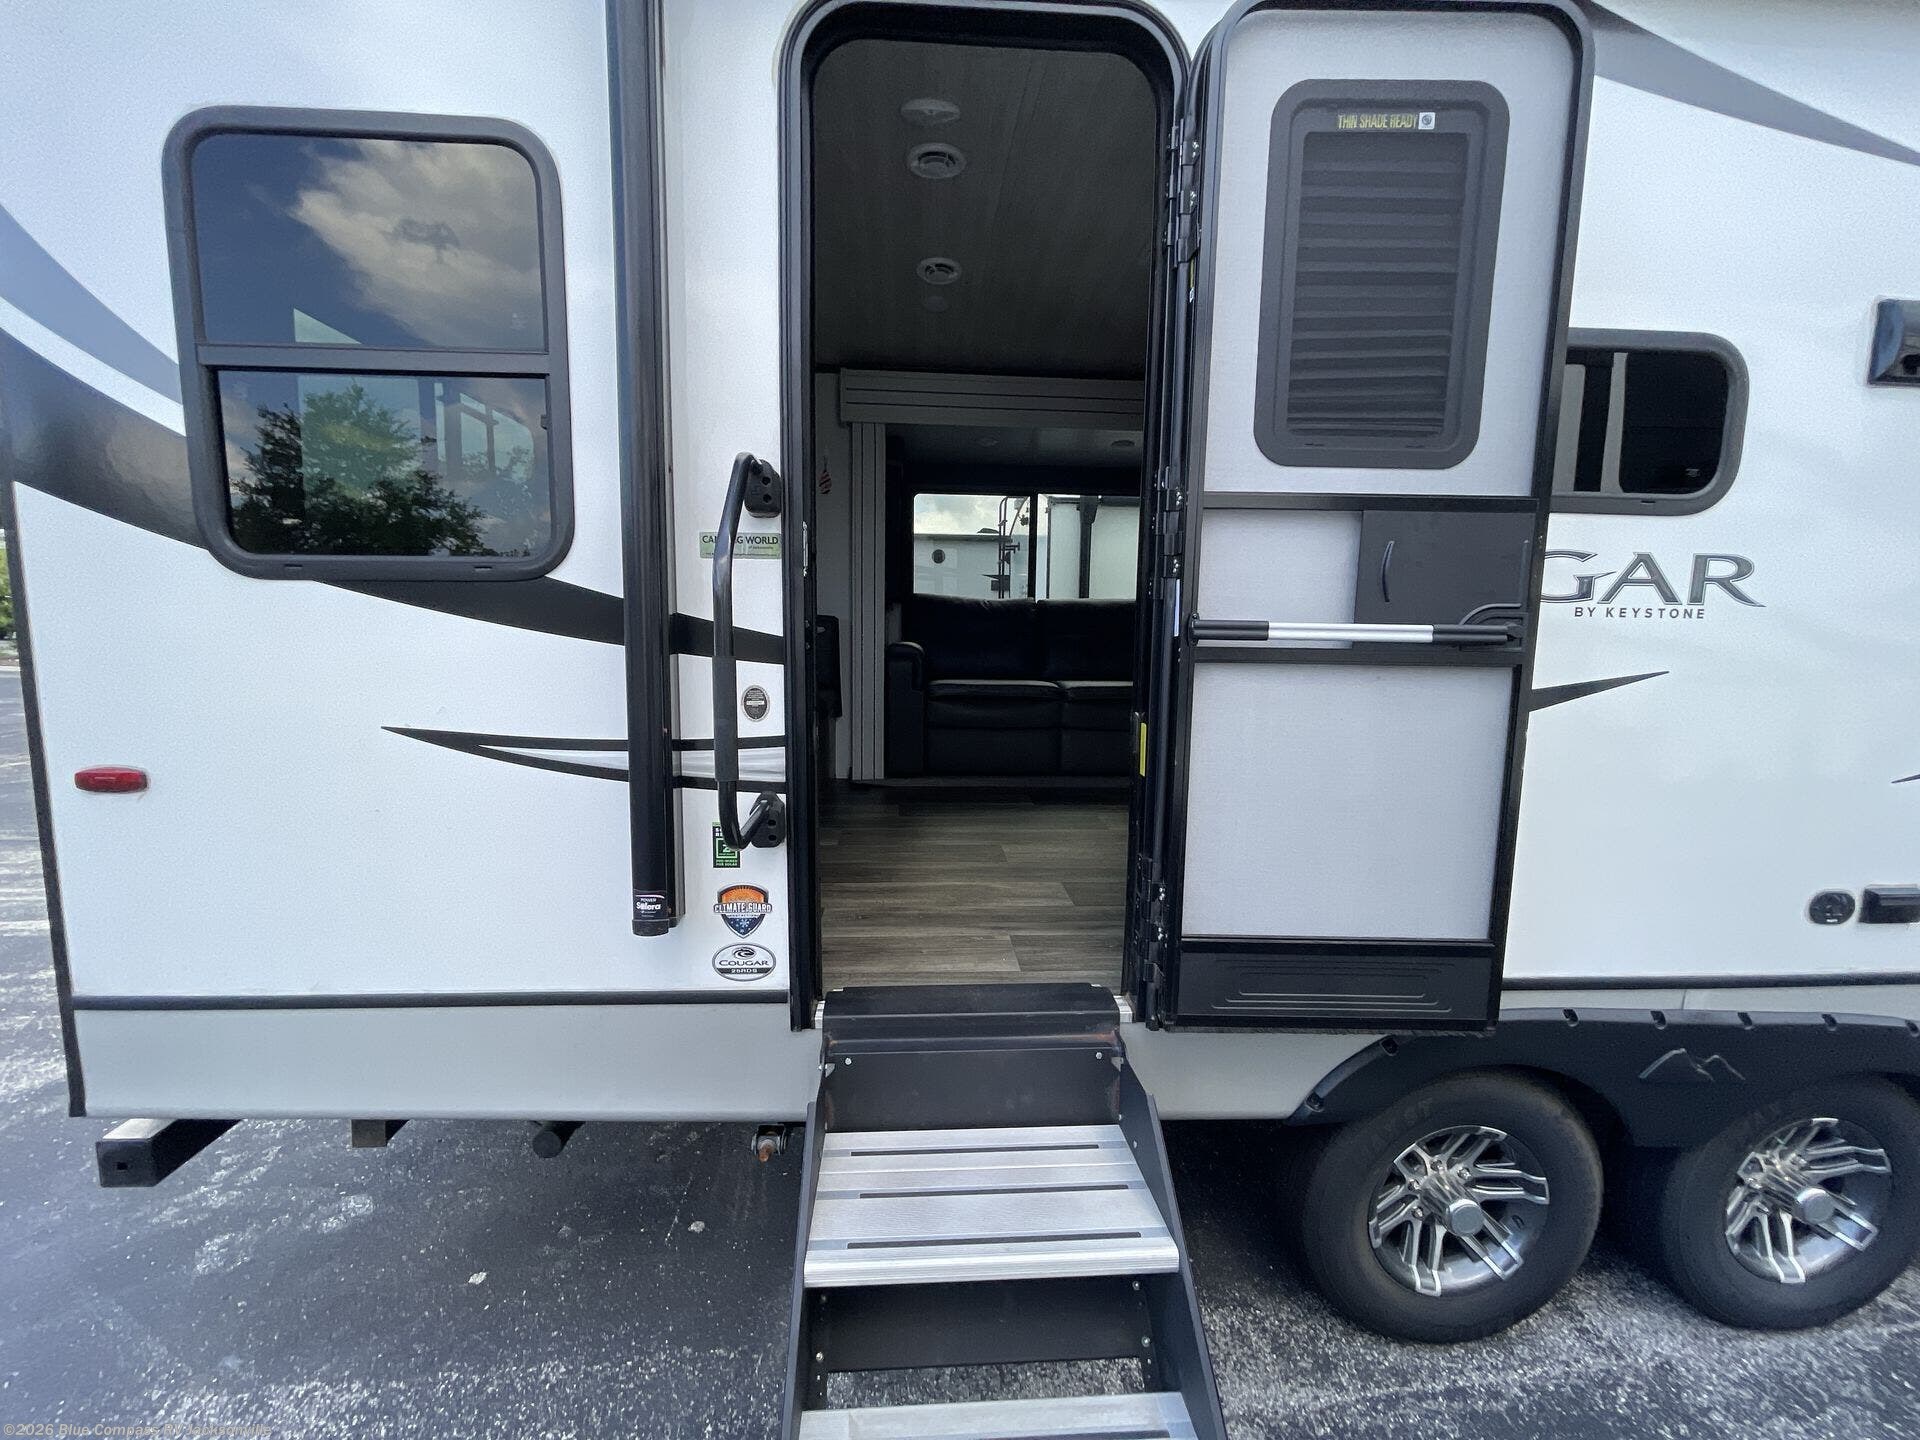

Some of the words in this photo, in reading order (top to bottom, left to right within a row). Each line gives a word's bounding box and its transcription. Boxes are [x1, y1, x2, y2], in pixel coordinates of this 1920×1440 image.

[1338, 114, 1357, 129] THIN
[1360, 113, 1388, 129] SHADE
[1390, 113, 1418, 129] READY
[745, 535, 779, 545] WORLD
[1540, 549, 1766, 608] GAR
[1574, 607, 1596, 618] BY
[1605, 606, 1705, 619] KEYSTONE
[714, 902, 746, 913] CLIMATE
[748, 902, 772, 913] GUARD
[719, 959, 770, 967] COUGAR
